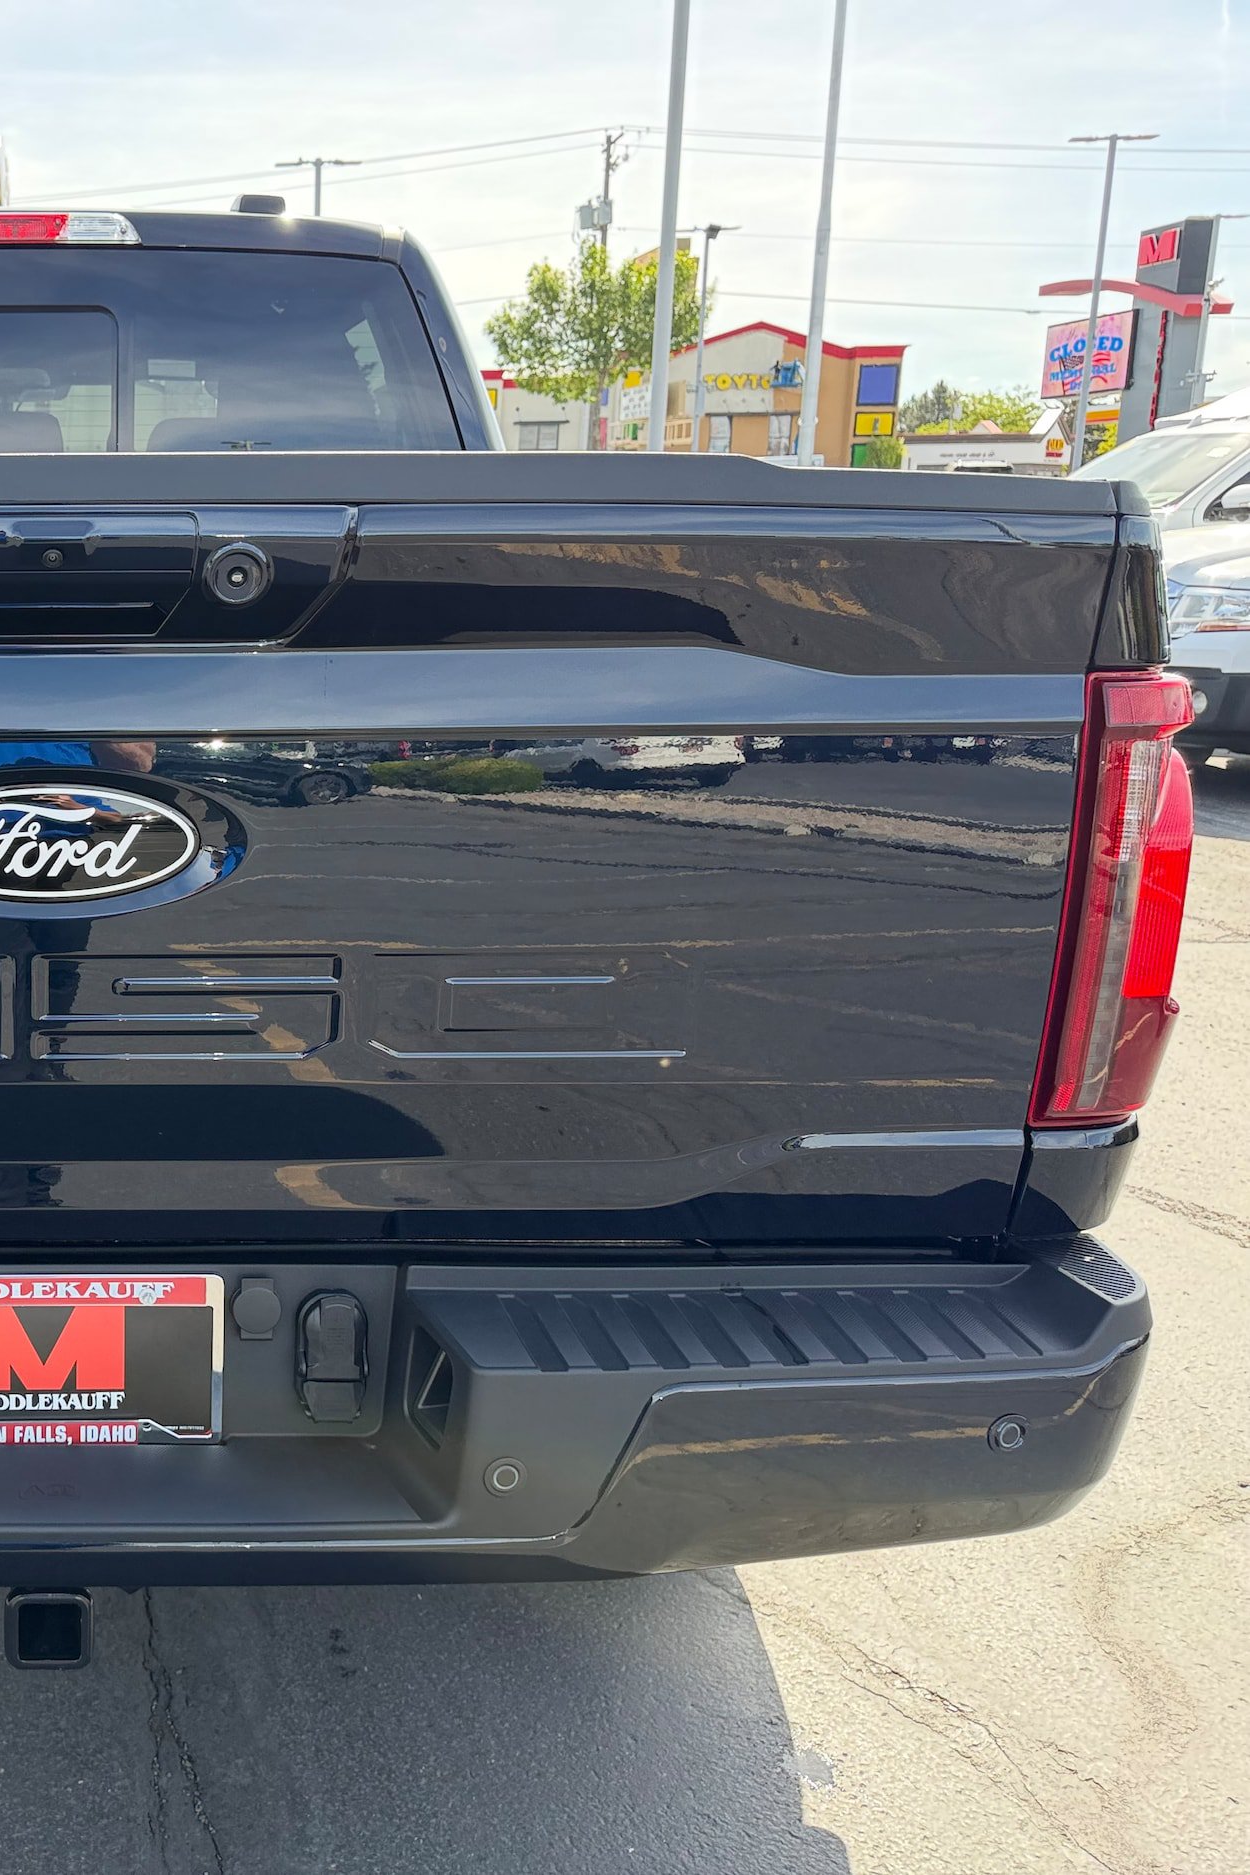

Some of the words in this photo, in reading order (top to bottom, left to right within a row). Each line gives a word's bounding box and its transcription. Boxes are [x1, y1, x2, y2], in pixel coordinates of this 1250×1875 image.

[1139, 228, 1180, 269] M
[1049, 335, 1124, 363] CLOED
[14, 1425, 73, 1445] FALLS,
[80, 1424, 137, 1443] IDAHO
